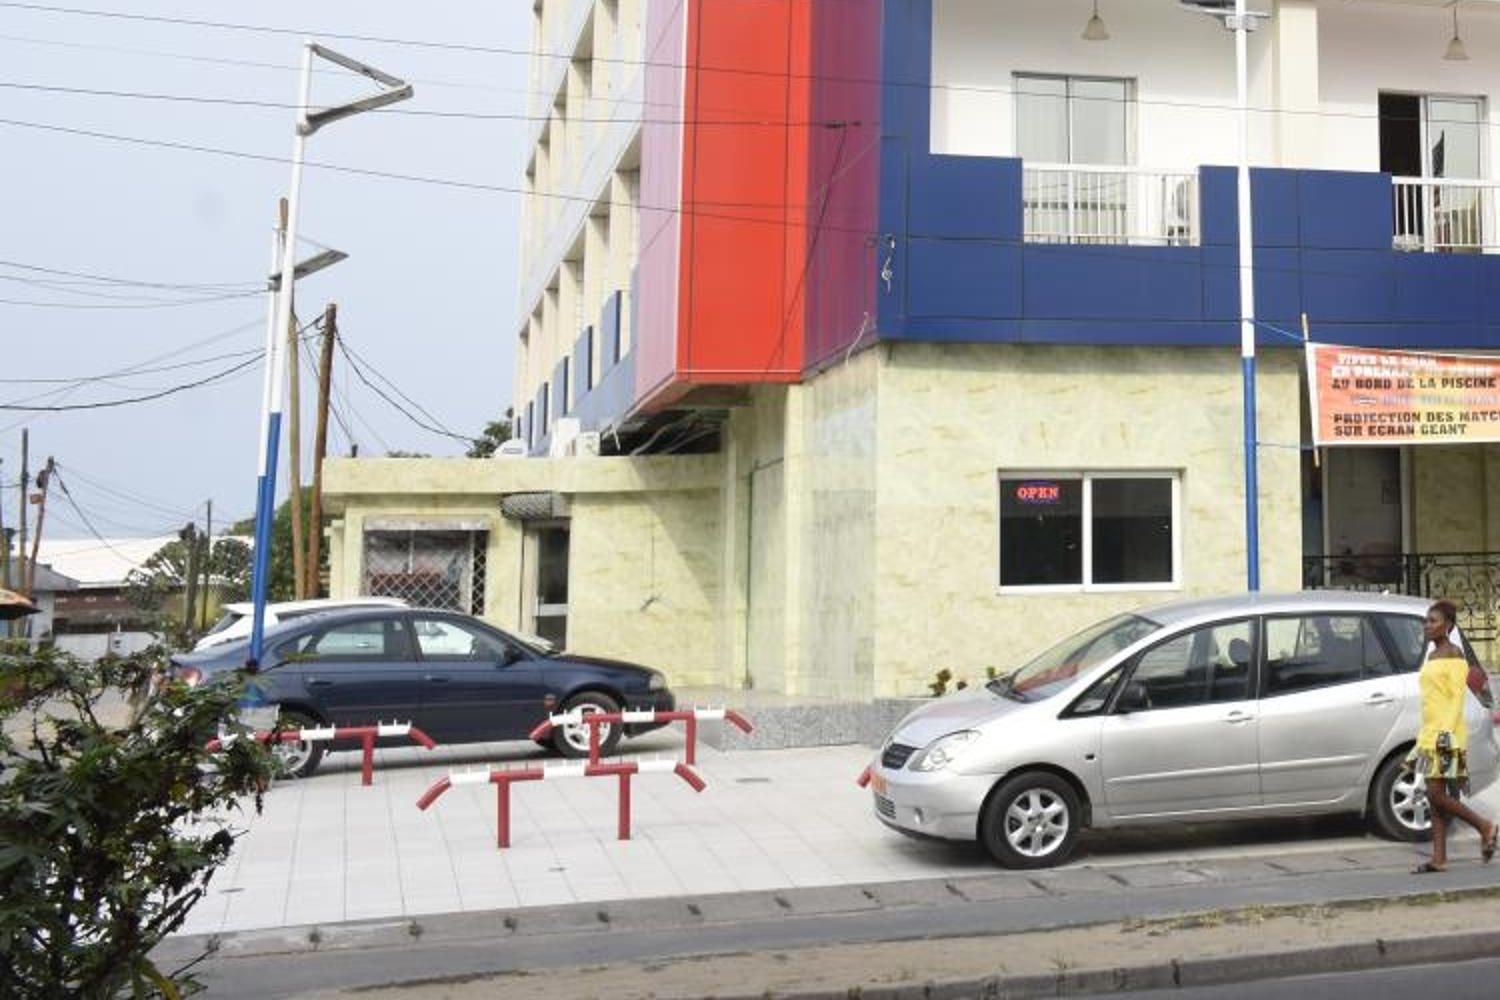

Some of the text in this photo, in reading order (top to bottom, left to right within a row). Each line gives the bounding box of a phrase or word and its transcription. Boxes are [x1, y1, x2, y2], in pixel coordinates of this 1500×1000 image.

[1397, 377, 1414, 389] DE
[1419, 377, 1436, 389] LA
[1442, 376, 1496, 389] PISCINE
[1333, 411, 1420, 424] PROJECTION
[1427, 411, 1454, 422] DES
[1334, 423, 1467, 437] SUR ECRAN GEANT
[1017, 487, 1059, 499] OPEN
